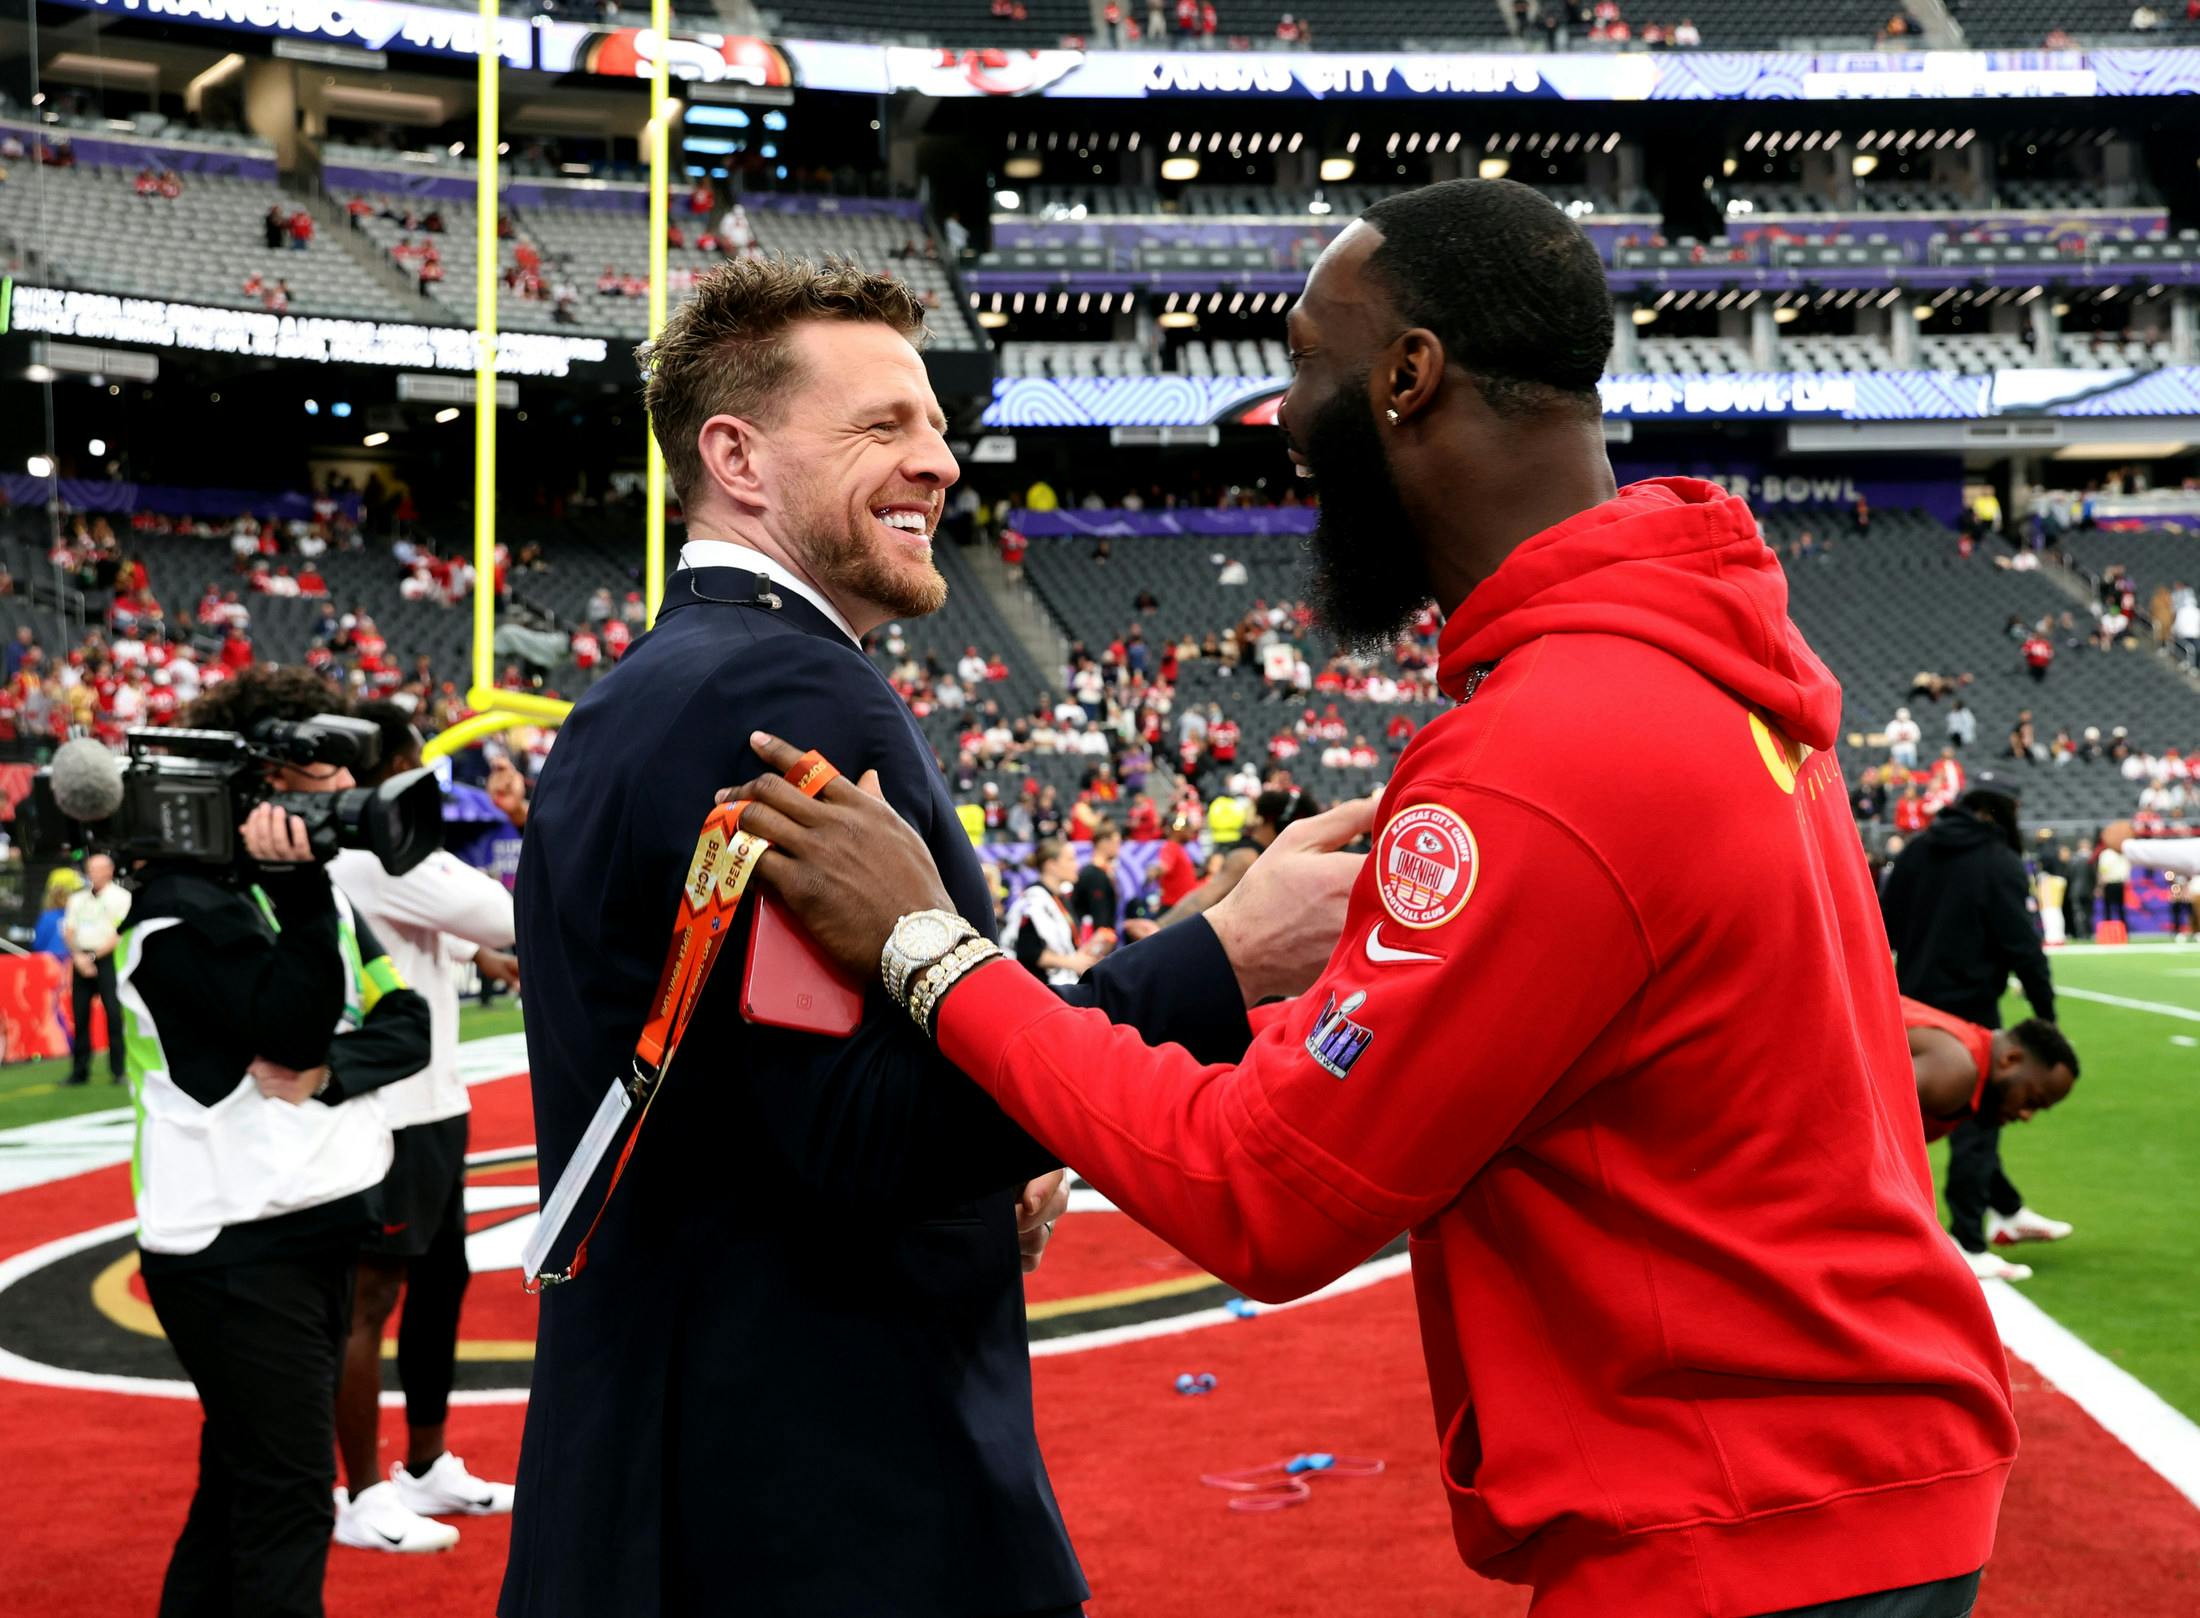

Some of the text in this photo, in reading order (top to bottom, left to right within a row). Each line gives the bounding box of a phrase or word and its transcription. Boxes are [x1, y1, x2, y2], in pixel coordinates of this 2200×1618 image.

[1303, 57, 1394, 92] CITY
[1763, 476, 1860, 502] BOWL
[1391, 810, 1470, 862] KANSAS CITY CHIEFS
[695, 839, 719, 896] BENCH
[1396, 851, 1445, 890] OMENIHU
[1384, 884, 1446, 921] FOOTBALL CLUB
[679, 924, 692, 959] SUPER
[667, 960, 682, 993] BOWL
